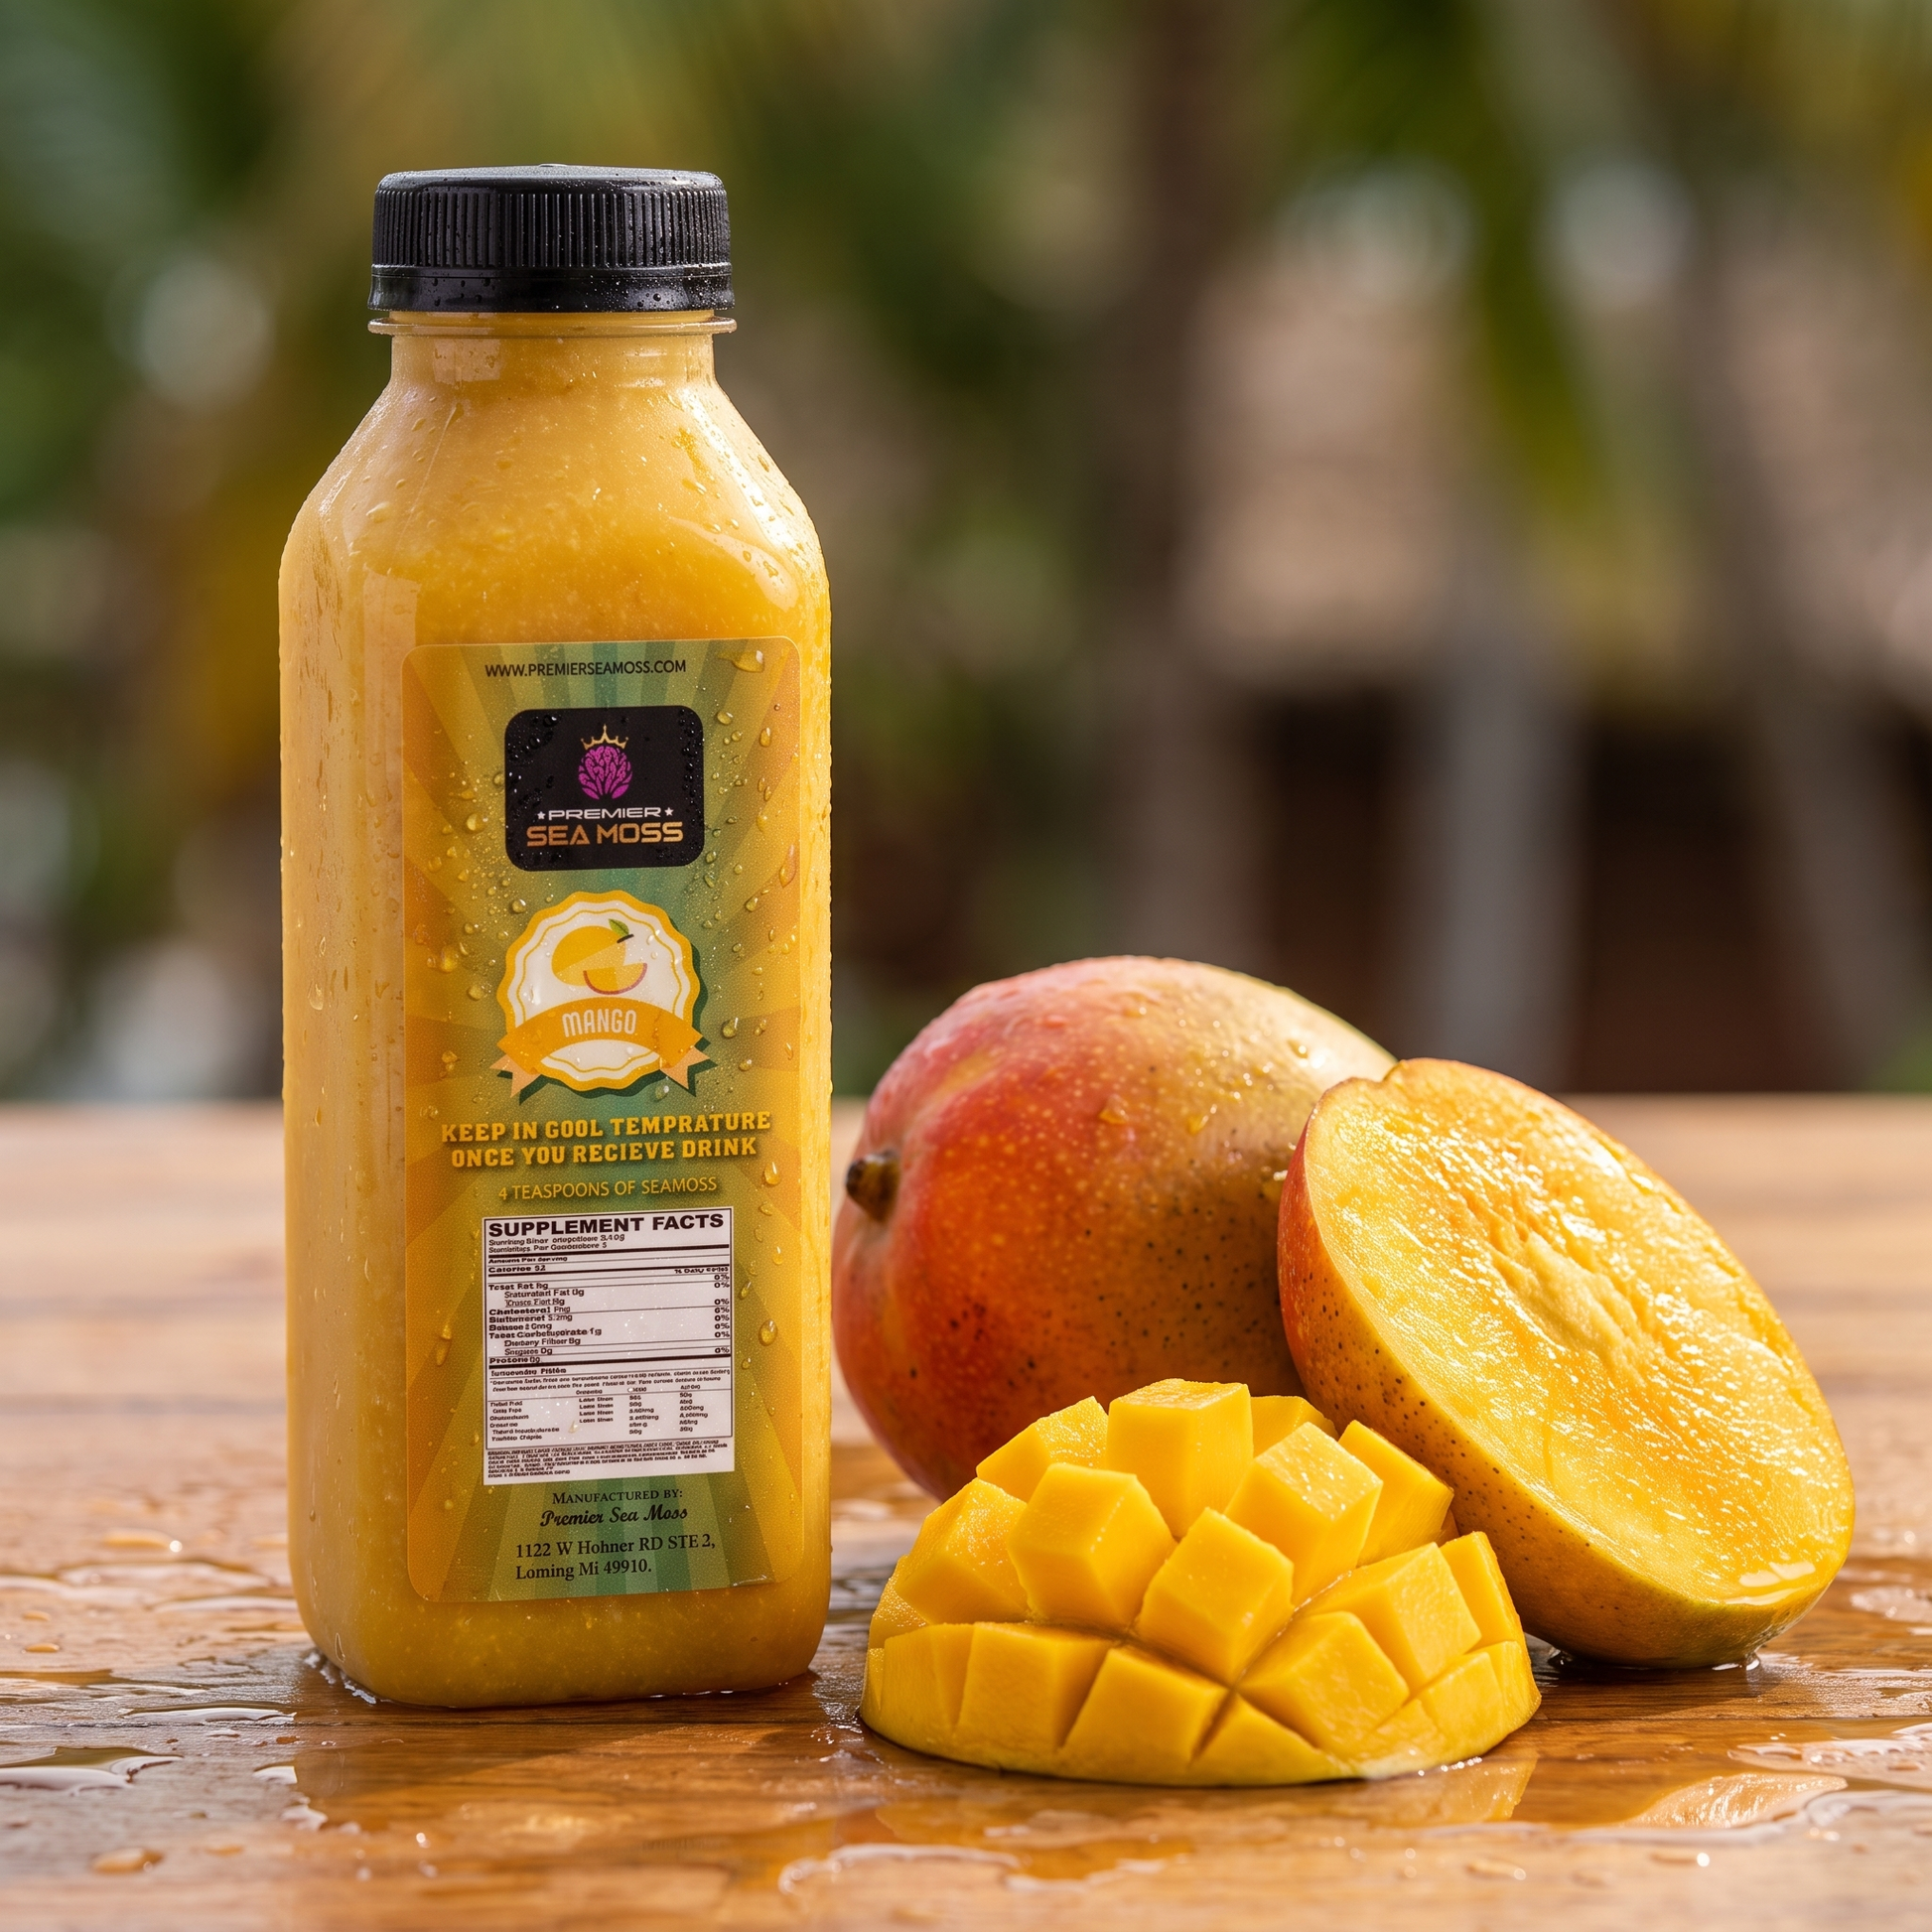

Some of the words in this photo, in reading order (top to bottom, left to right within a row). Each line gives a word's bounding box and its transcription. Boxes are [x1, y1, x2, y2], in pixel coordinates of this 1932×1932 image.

[484, 659, 687, 678] WWW.PREMIERSEAMOSS.COM
[548, 806, 662, 821] PREMIER
[526, 824, 591, 847] SEA
[597, 821, 684, 845] MOSS
[561, 1009, 637, 1038] MANGO
[441, 1122, 506, 1142] KEEP
[512, 1121, 538, 1141] IN
[610, 1111, 771, 1137] TEMPRATURE
[452, 1148, 514, 1168] ONCE
[521, 1146, 566, 1166] YOU
[573, 1141, 675, 1164] RECIEVE
[682, 1137, 757, 1159] DRINK
[498, 1186, 508, 1200] 4
[511, 1181, 610, 1199] TEASPOONS
[614, 1180, 636, 1196] OF
[641, 1176, 718, 1194] SEAMOSS
[488, 1217, 645, 1237] SUPPLEMENT
[652, 1213, 724, 1231] FACTS
[539, 1509, 605, 1527] Premier
[609, 1506, 639, 1523] Sea
[643, 1504, 688, 1521] Moss
[516, 1543, 551, 1558] 1122
[556, 1542, 574, 1555] W
[577, 1540, 634, 1555] Hohner
[638, 1537, 663, 1551] RD
[667, 1535, 699, 1550] STE
[701, 1533, 716, 1549] 2,
[515, 1564, 575, 1582] Loming
[578, 1561, 600, 1576] Mi
[603, 1558, 652, 1575] 49910.
